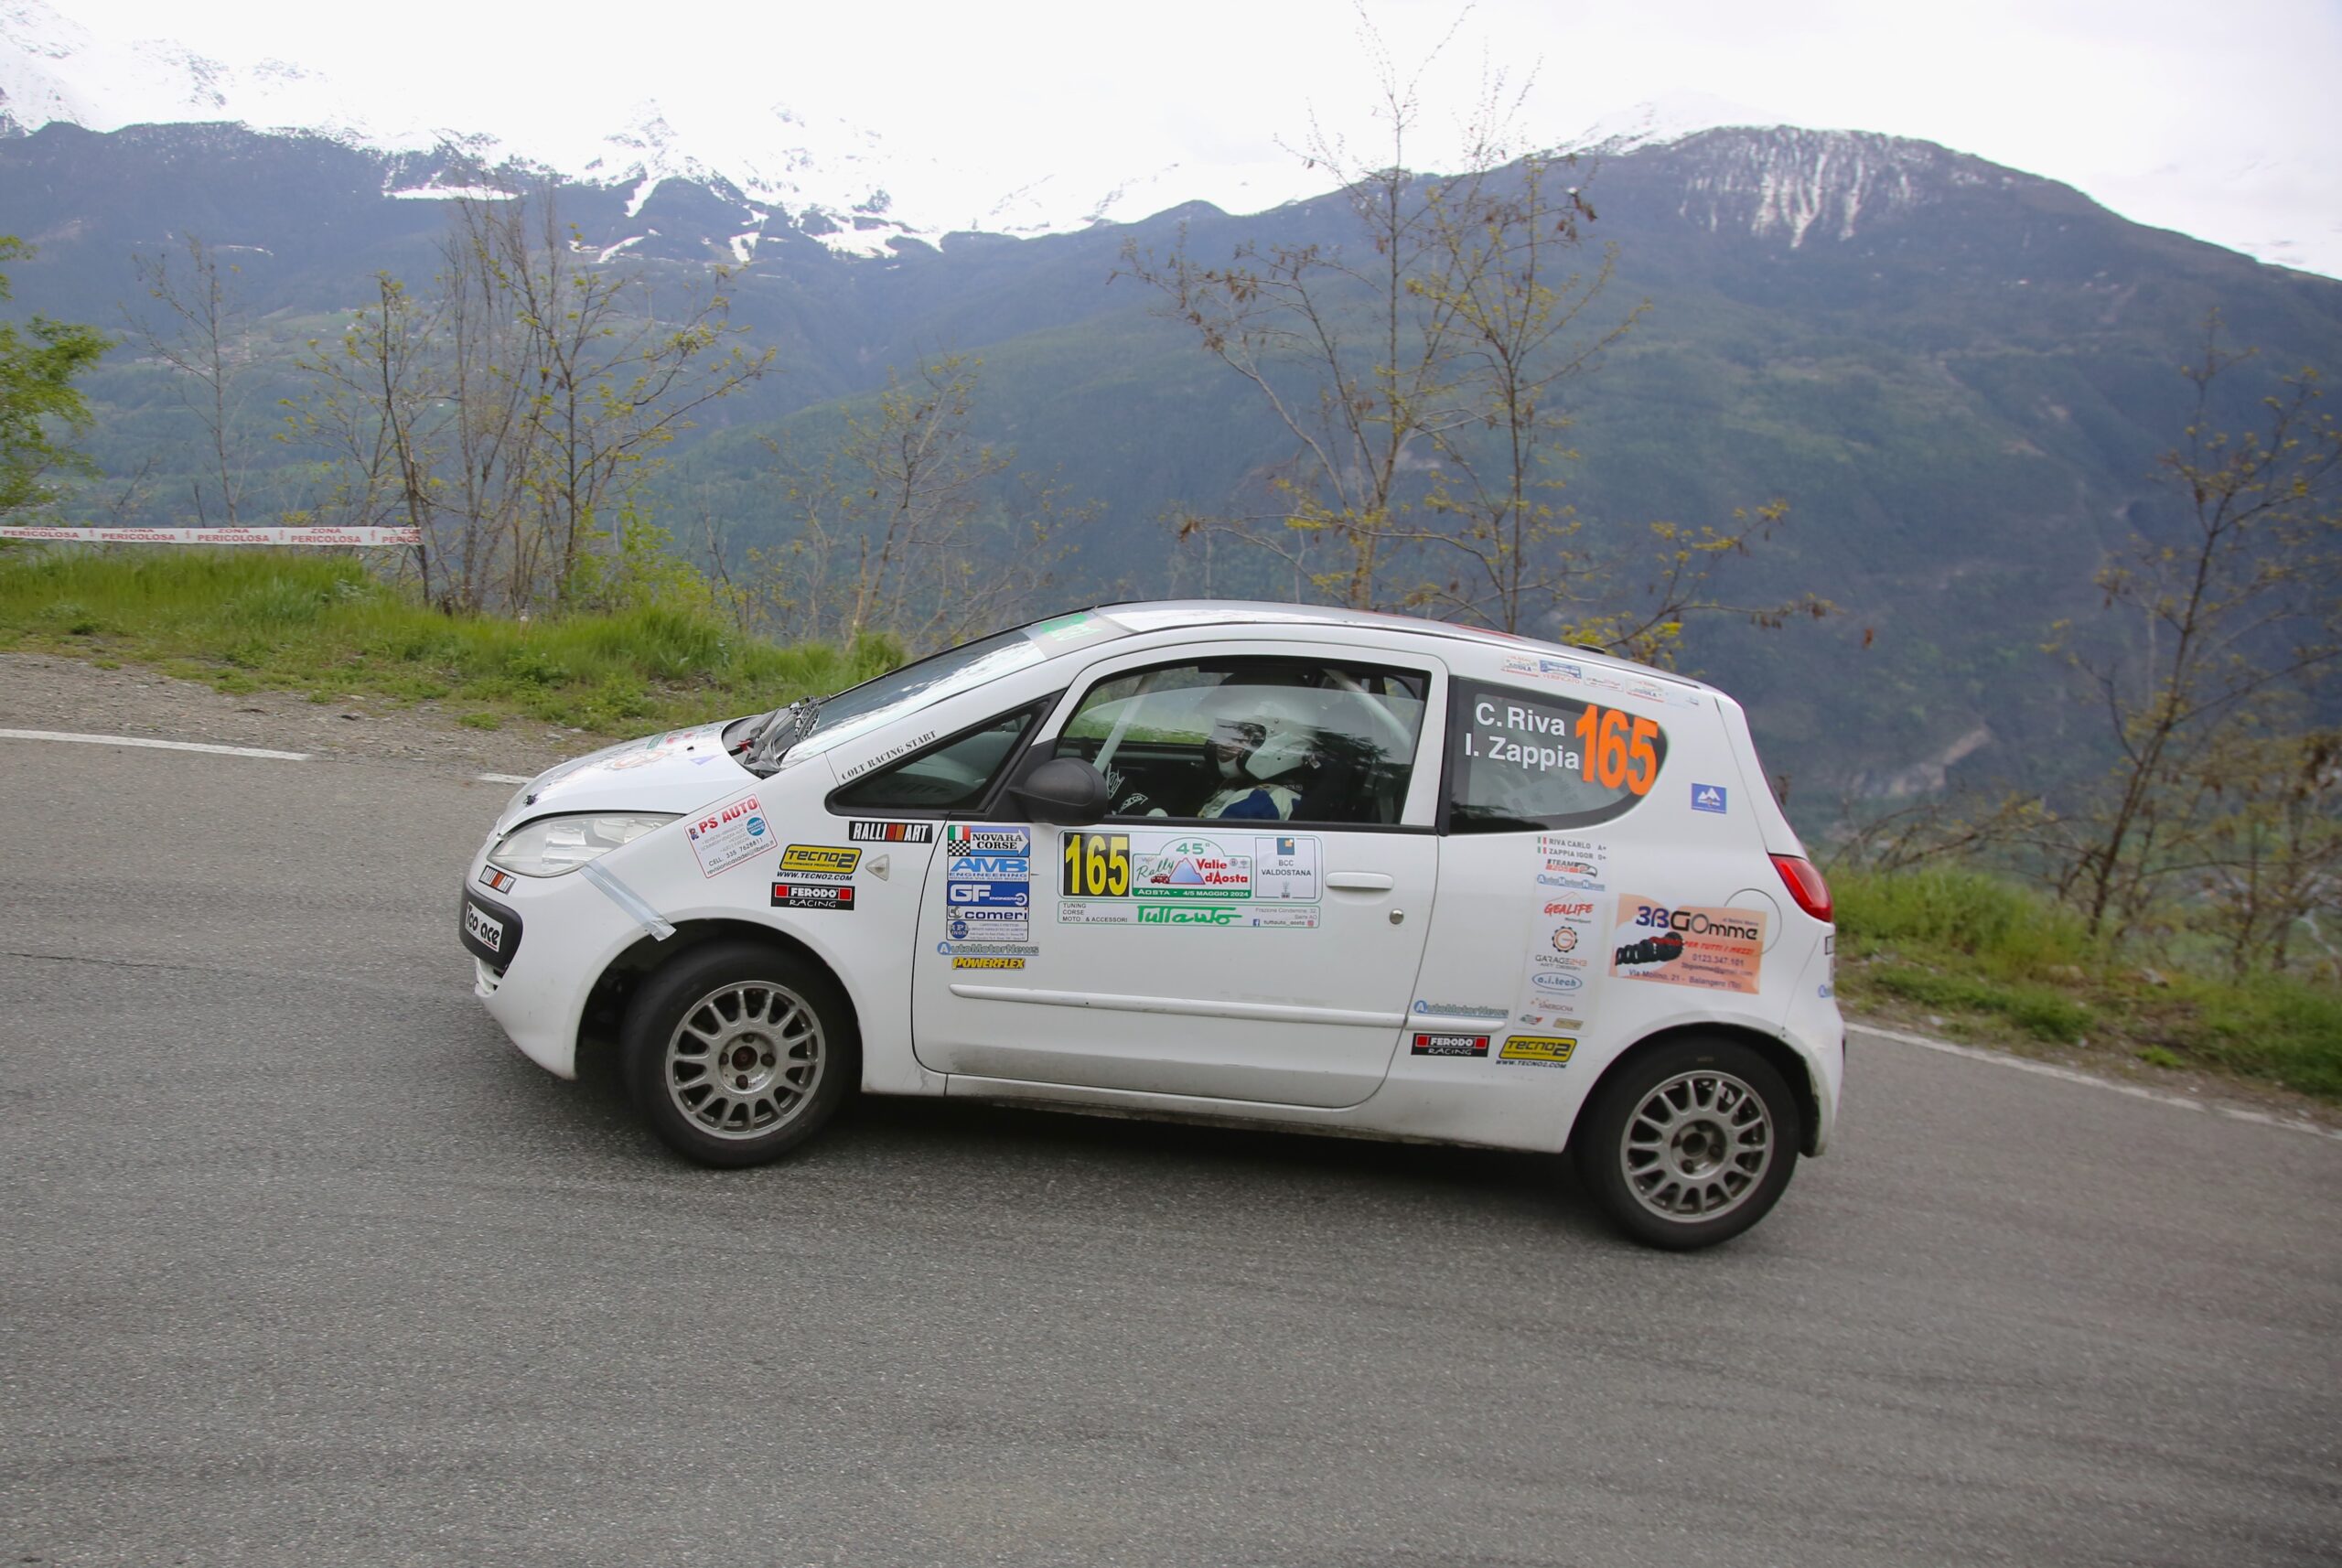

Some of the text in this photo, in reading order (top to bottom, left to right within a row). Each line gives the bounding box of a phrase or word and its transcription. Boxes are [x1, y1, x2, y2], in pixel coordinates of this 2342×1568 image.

[3, 530, 80, 539] PERICOLOSA
[101, 532, 176, 541] PERICOLOSA
[197, 534, 270, 542] PERICOLOSA
[290, 535, 362, 543] PERICOLOSA
[1476, 702, 1565, 737] C. Riva
[842, 730, 937, 780] COLT RACING START
[1465, 733, 1580, 772] I. Zappia
[1575, 703, 1658, 796] 165
[698, 817, 719, 834] PS
[721, 798, 758, 823] AUTO
[853, 824, 929, 842] RALLI ART
[972, 833, 1023, 842] NOVARA
[977, 842, 1017, 850] CORSE
[1549, 848, 1575, 857] ZAPPIA
[950, 858, 1028, 872] AMB
[1065, 834, 1129, 896] 165
[1136, 858, 1174, 881] Rally
[777, 871, 853, 881] WWW.TECNO2.COM
[790, 887, 837, 898] FERODO
[950, 884, 991, 902] GF
[789, 899, 837, 908] RACING
[965, 908, 1027, 919] comeri
[1544, 903, 1595, 917] GEALIFE
[937, 941, 1040, 956] AutoMotorNews
[953, 957, 1025, 969] POWERFLEX
[1537, 975, 1577, 987] a.i.tech
[1430, 1038, 1473, 1047] FERODO
[1495, 1059, 1567, 1069] WWW.TECNO2.COM
